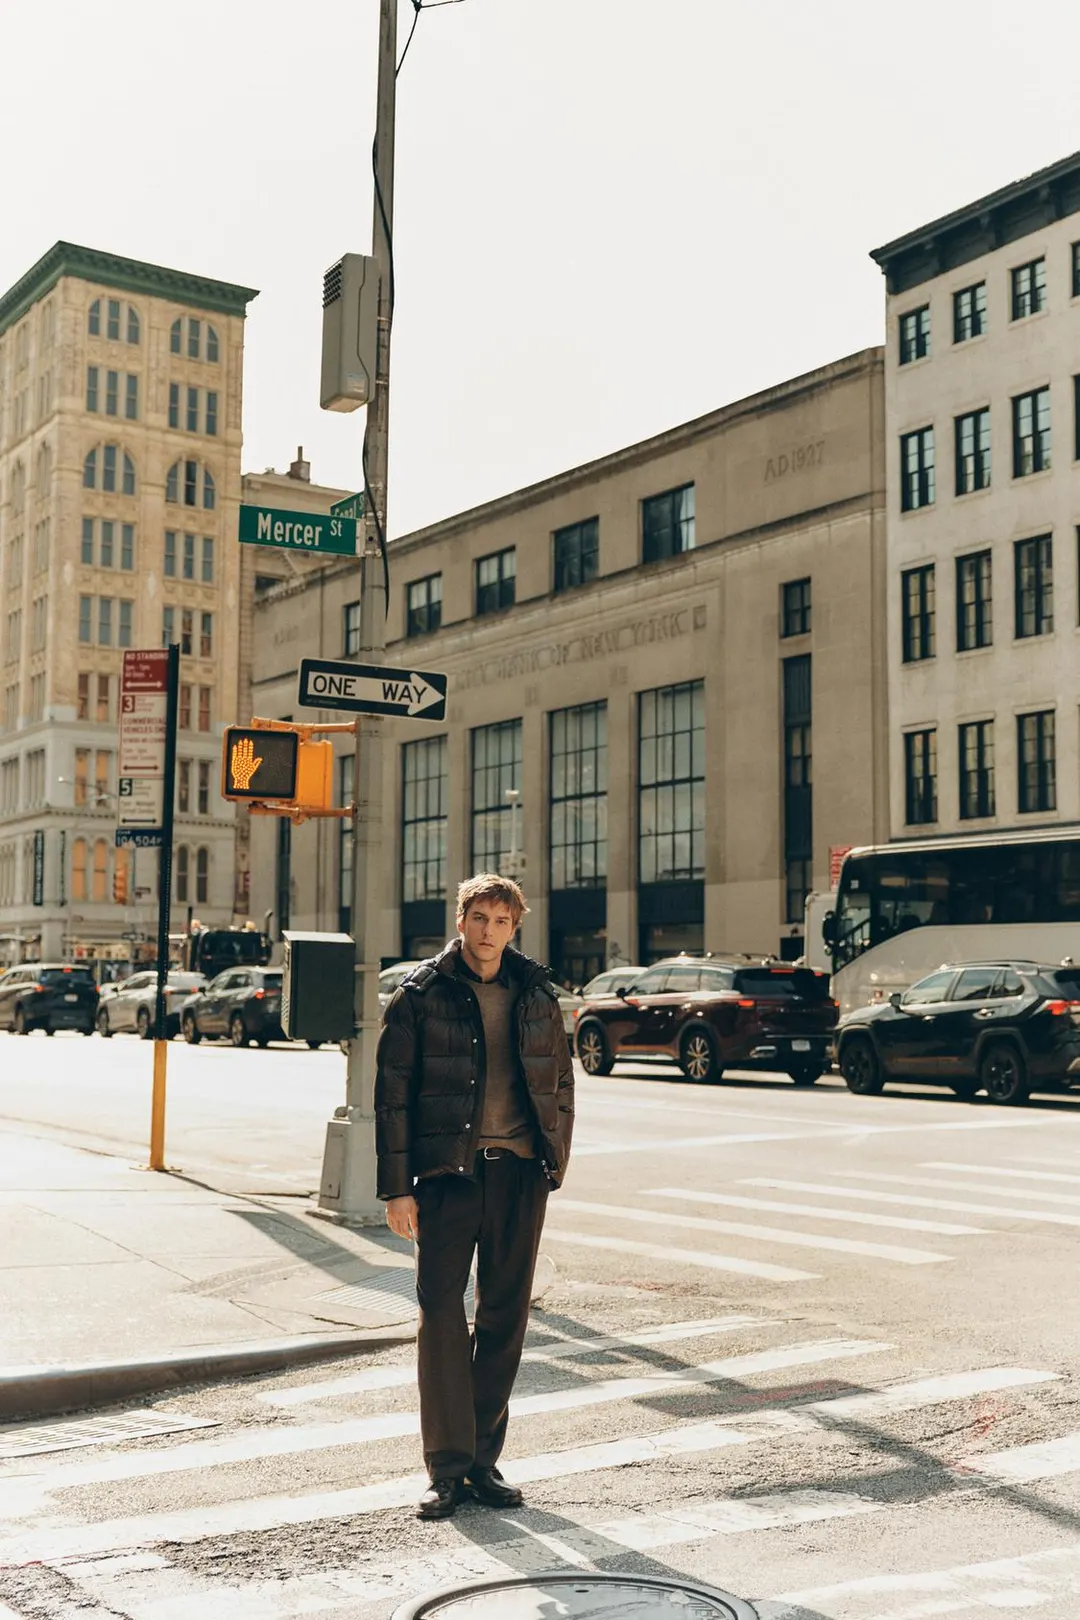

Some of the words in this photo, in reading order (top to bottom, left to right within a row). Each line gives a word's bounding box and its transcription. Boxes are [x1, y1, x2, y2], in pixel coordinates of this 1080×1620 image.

[257, 512, 323, 546] Mercer
[330, 520, 343, 537] St
[579, 628, 620, 658] NEW
[125, 652, 136, 661] NO
[313, 674, 357, 697] ONE
[382, 682, 428, 704] WAY
[123, 696, 133, 712] 3
[121, 779, 131, 795] 5
